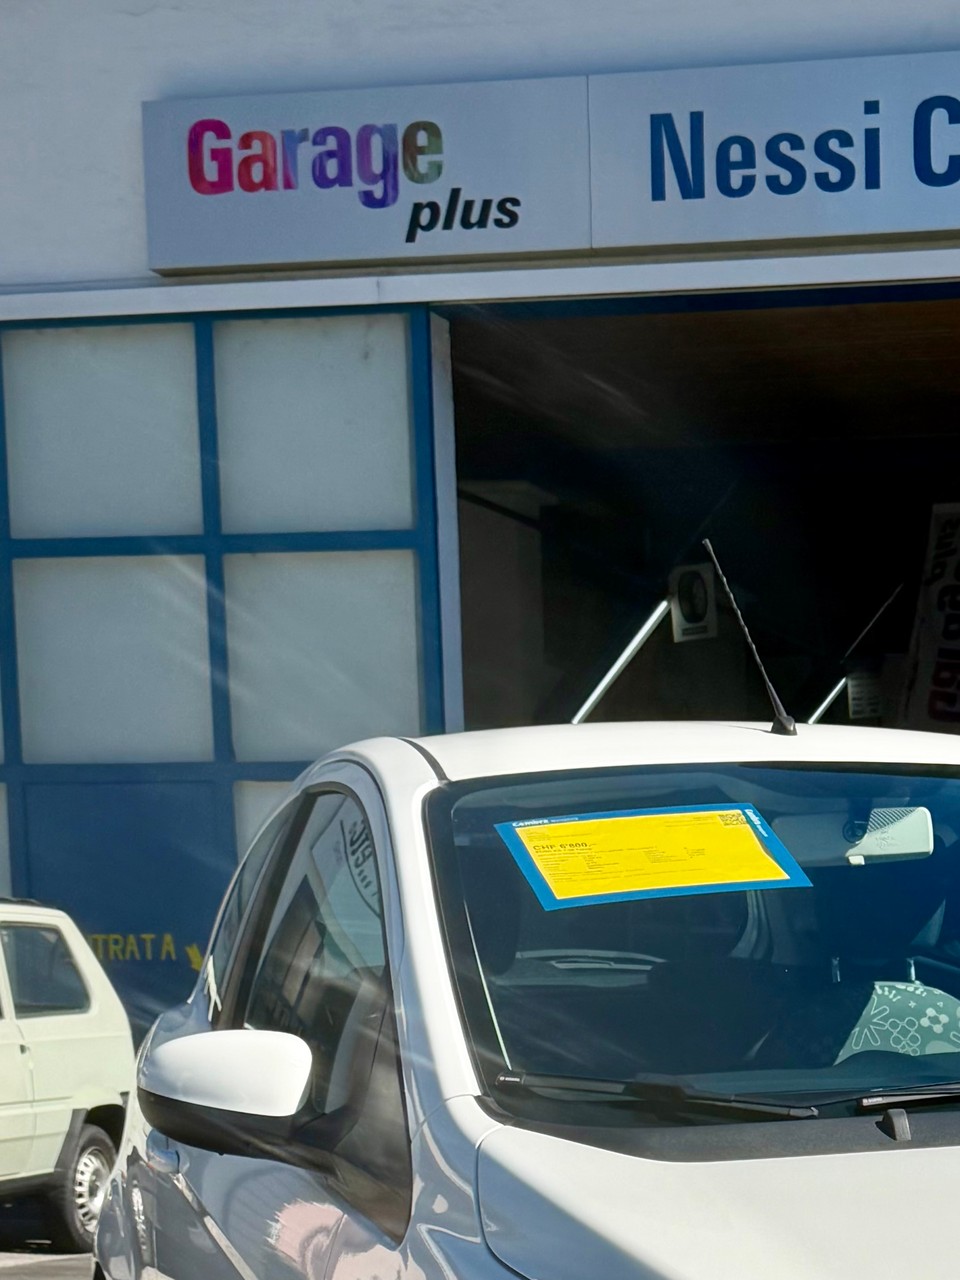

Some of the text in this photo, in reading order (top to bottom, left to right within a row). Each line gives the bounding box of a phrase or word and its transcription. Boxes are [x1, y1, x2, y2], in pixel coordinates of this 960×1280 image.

[186, 116, 444, 210] Garage
[649, 99, 882, 202] Nessi
[404, 184, 521, 243] plus
[89, 933, 177, 961] TRATA
